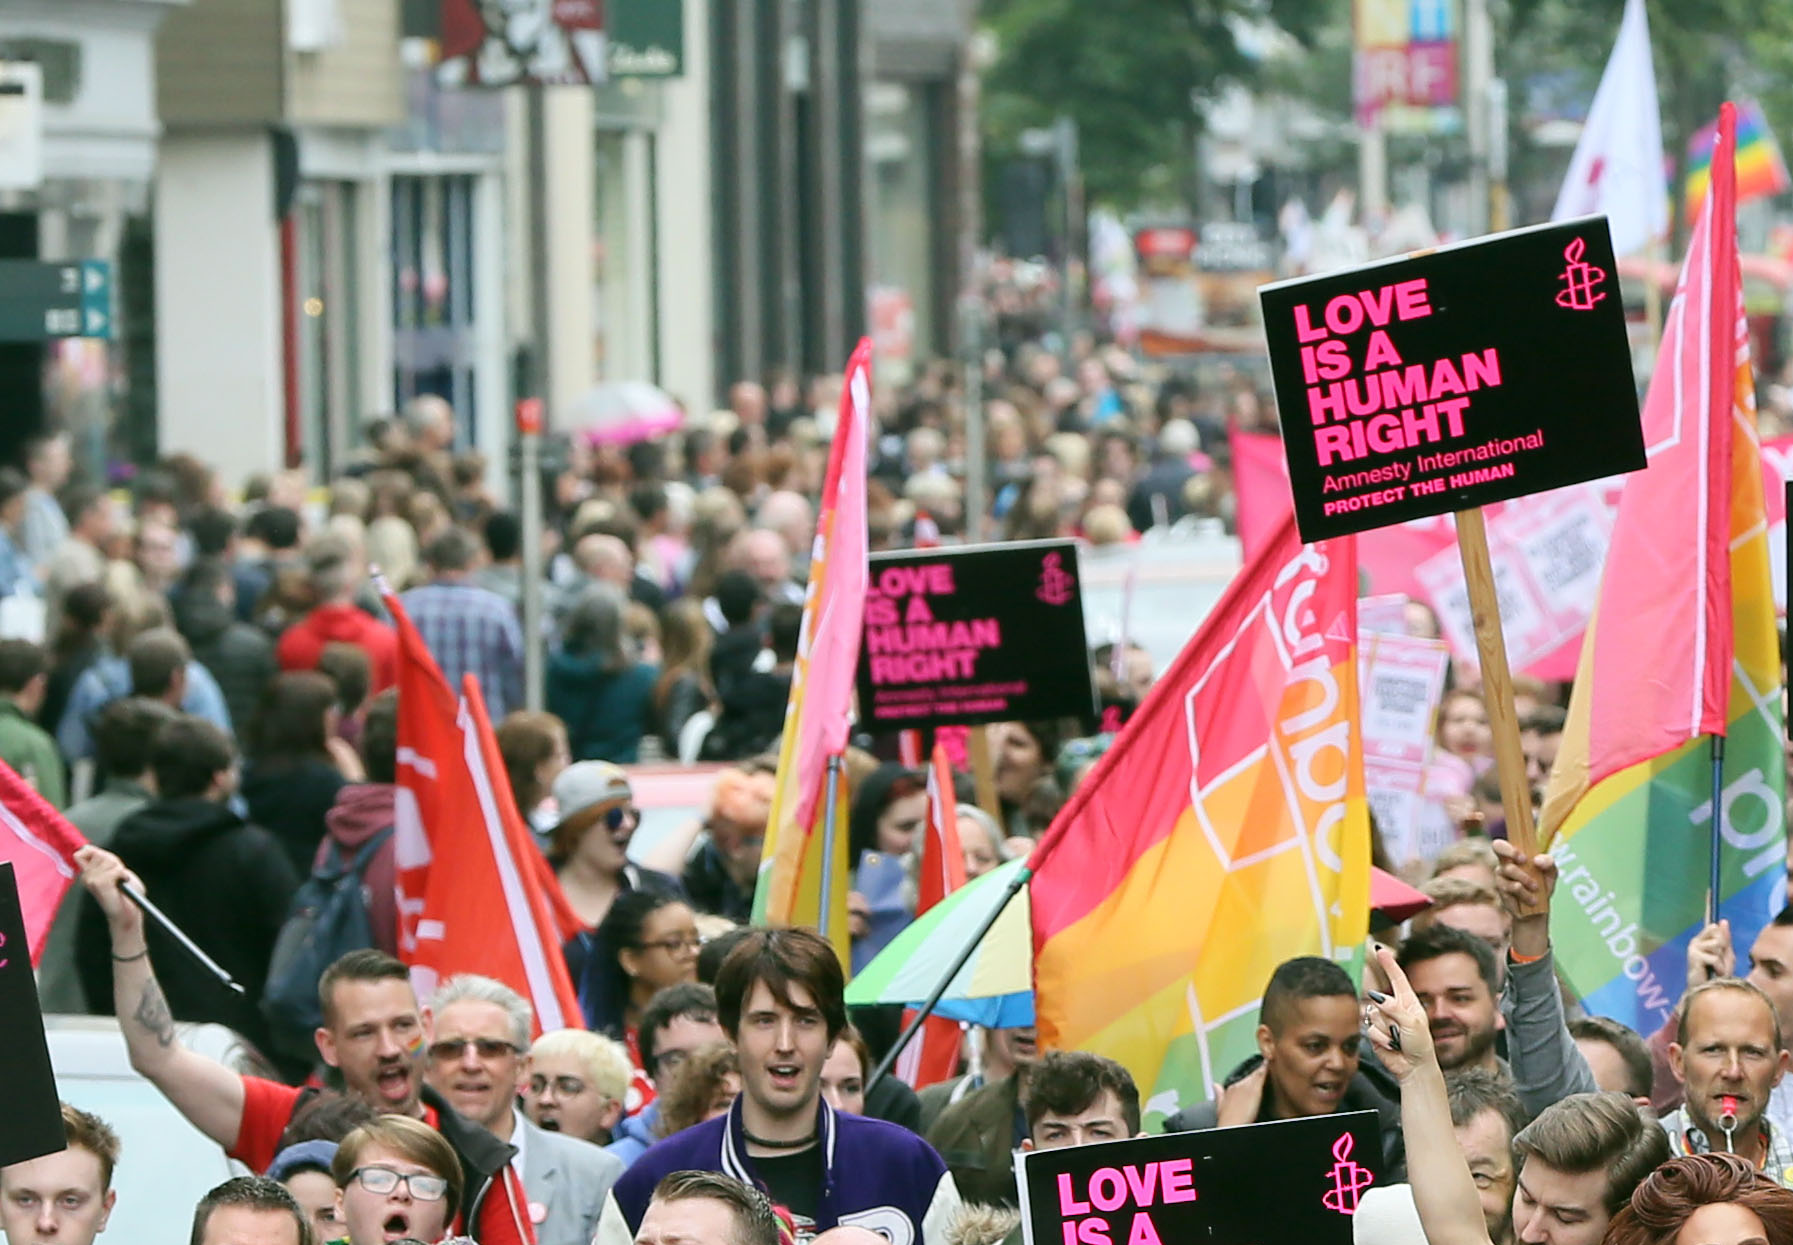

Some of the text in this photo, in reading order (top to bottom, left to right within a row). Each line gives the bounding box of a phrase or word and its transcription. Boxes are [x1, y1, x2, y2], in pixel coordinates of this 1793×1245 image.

[1293, 278, 1432, 343] LOVE
[1301, 330, 1402, 384] IS A
[1307, 347, 1503, 425] HUMAN
[1314, 397, 1472, 466] RIGHT
[1322, 428, 1544, 494] Amnesty International
[1324, 462, 1515, 517] PROTECT THE HUMAN
[866, 617, 1003, 653] HUMAN
[905, 595, 935, 624] A
[870, 648, 980, 685] RIGHT
[1057, 1158, 1197, 1217] LOVE
